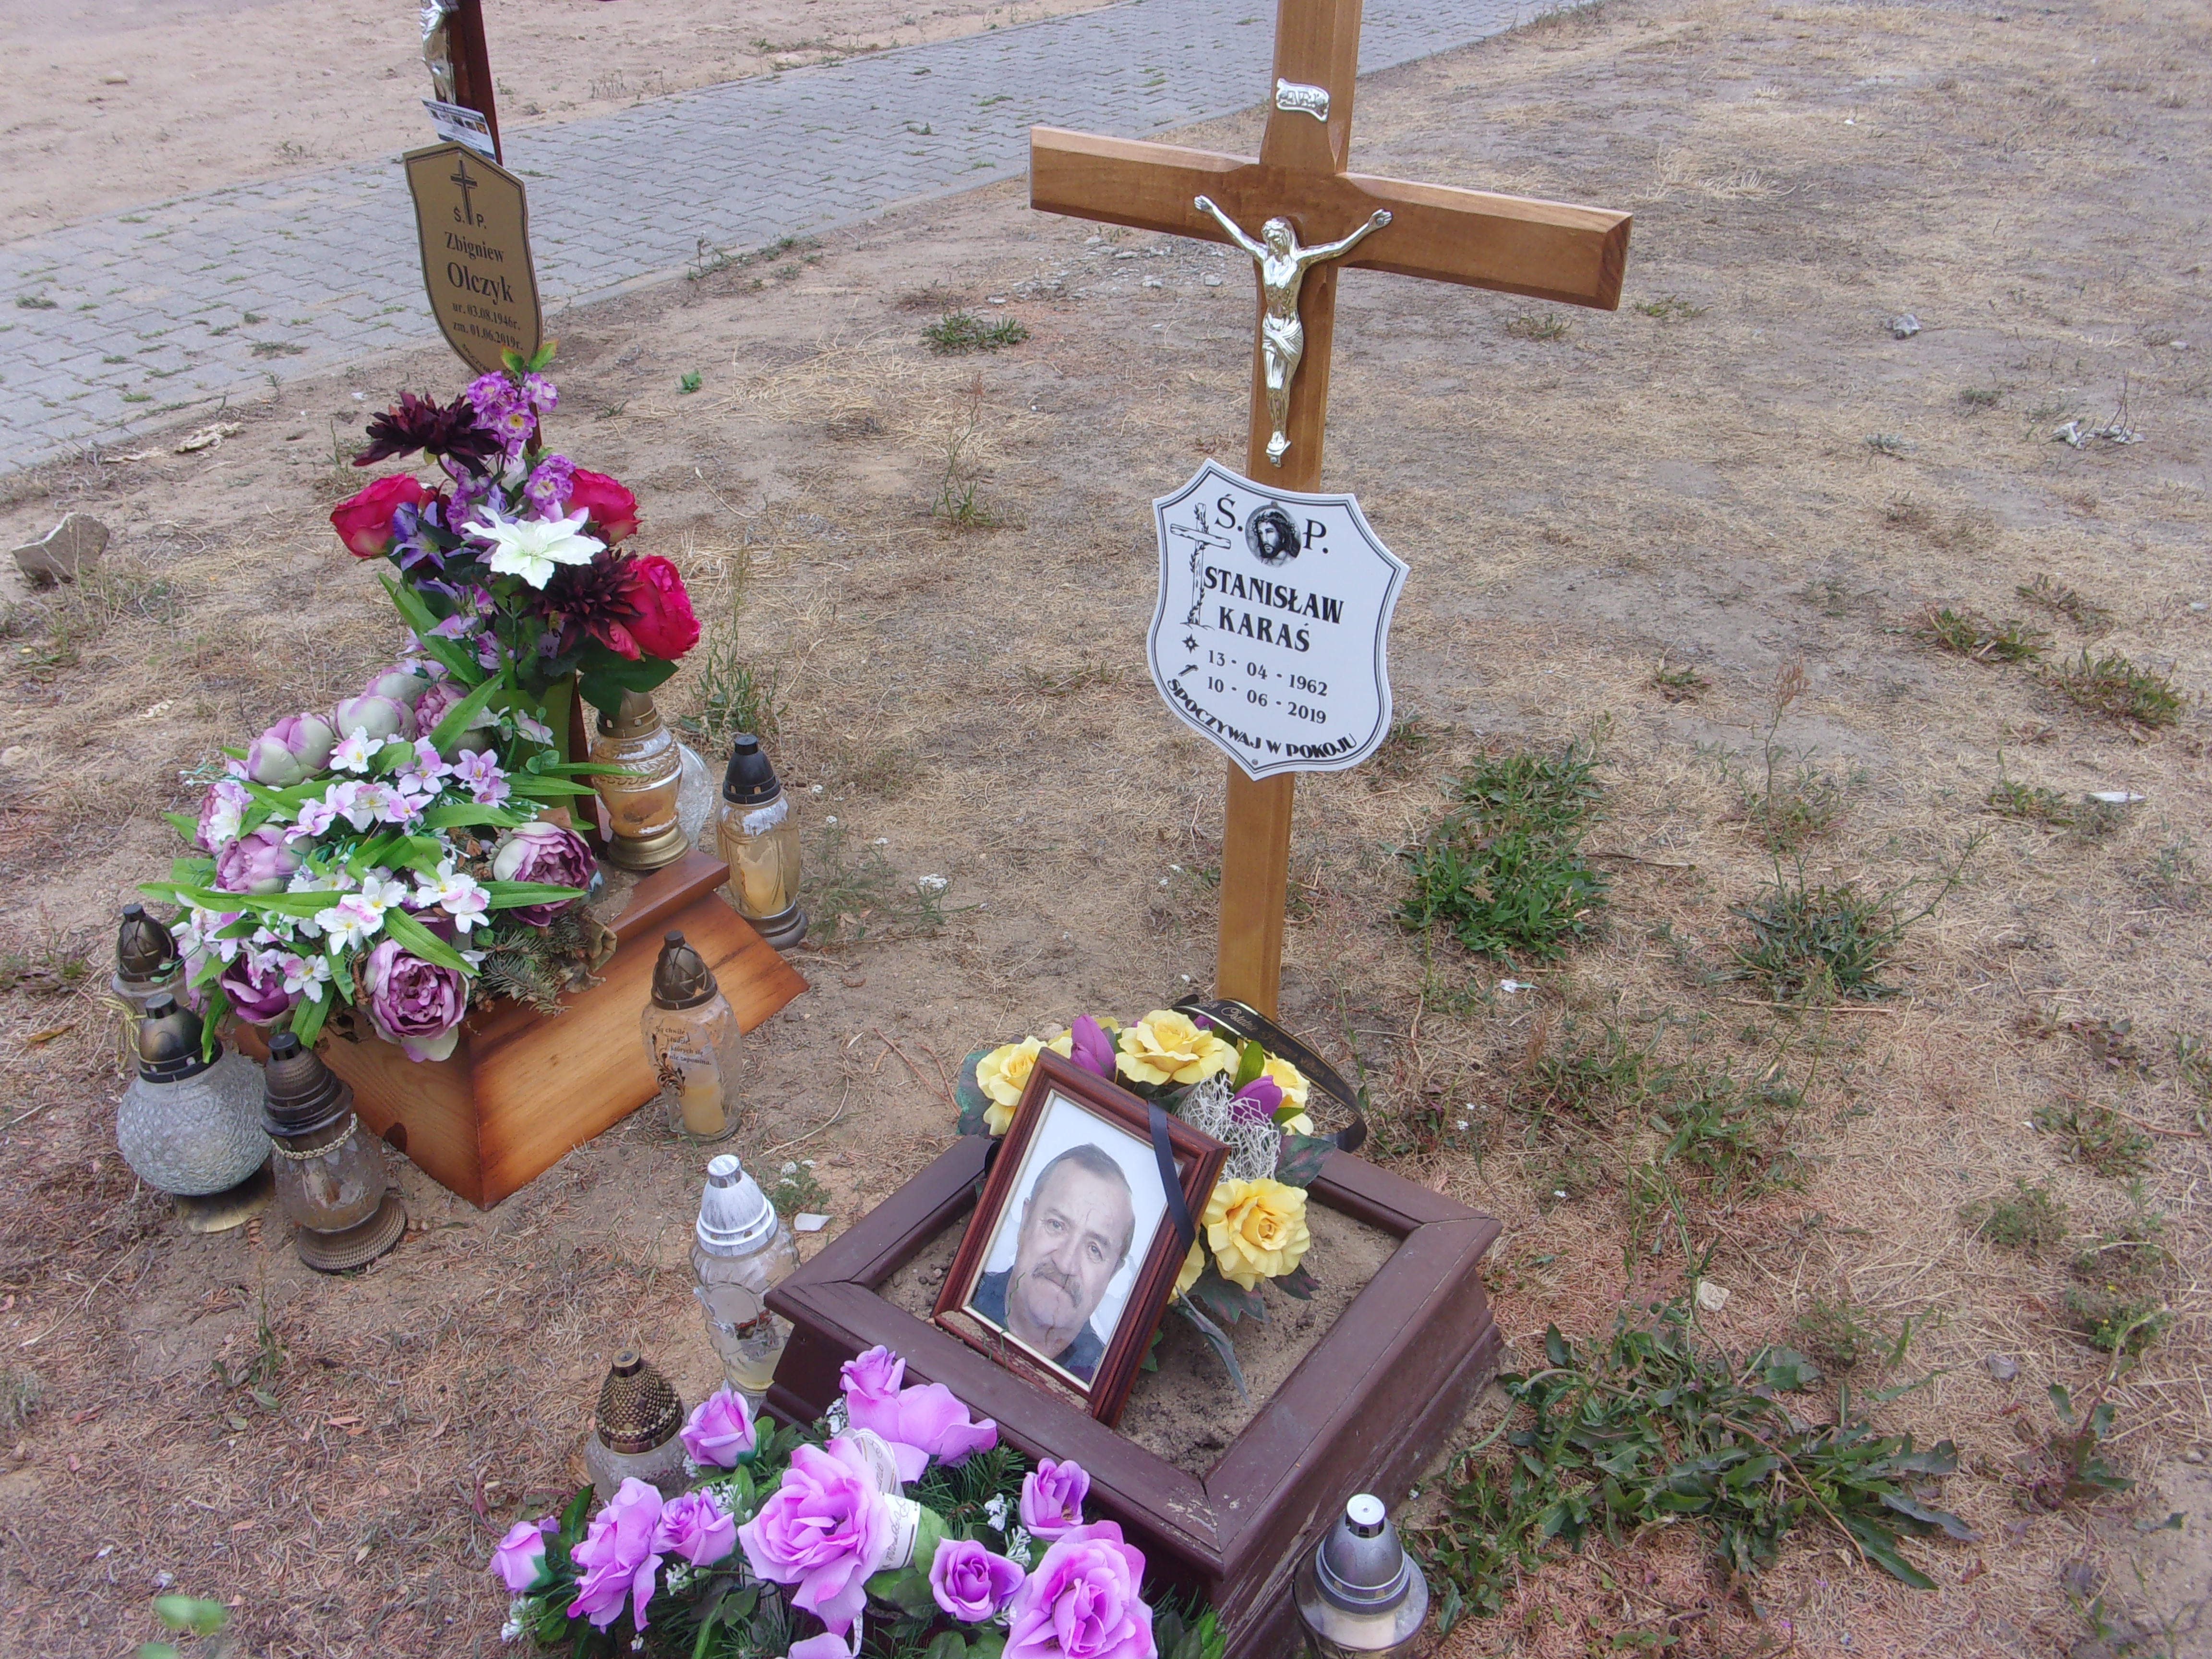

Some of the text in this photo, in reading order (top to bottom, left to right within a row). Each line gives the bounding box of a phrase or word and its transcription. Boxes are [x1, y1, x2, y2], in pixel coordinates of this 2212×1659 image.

[476, 214, 487, 229] P.
[445, 231, 504, 263] Zbigniew
[447, 262, 515, 305] Olczyk
[453, 303, 520, 330] ur. 03.08.1946r.
[453, 322, 469, 333] zm.
[1214, 494, 1329, 554] Ś. P.
[1203, 566, 1345, 624] STANISŁAW
[1219, 606, 1310, 652] KARAŚ
[1247, 662, 1267, 680] 04
[1289, 674, 1328, 697] 1962
[1167, 679, 1357, 758] SPOCZYWAJ W POKOJU
[1247, 690, 1268, 707] 06
[1287, 702, 1327, 724] 2019
